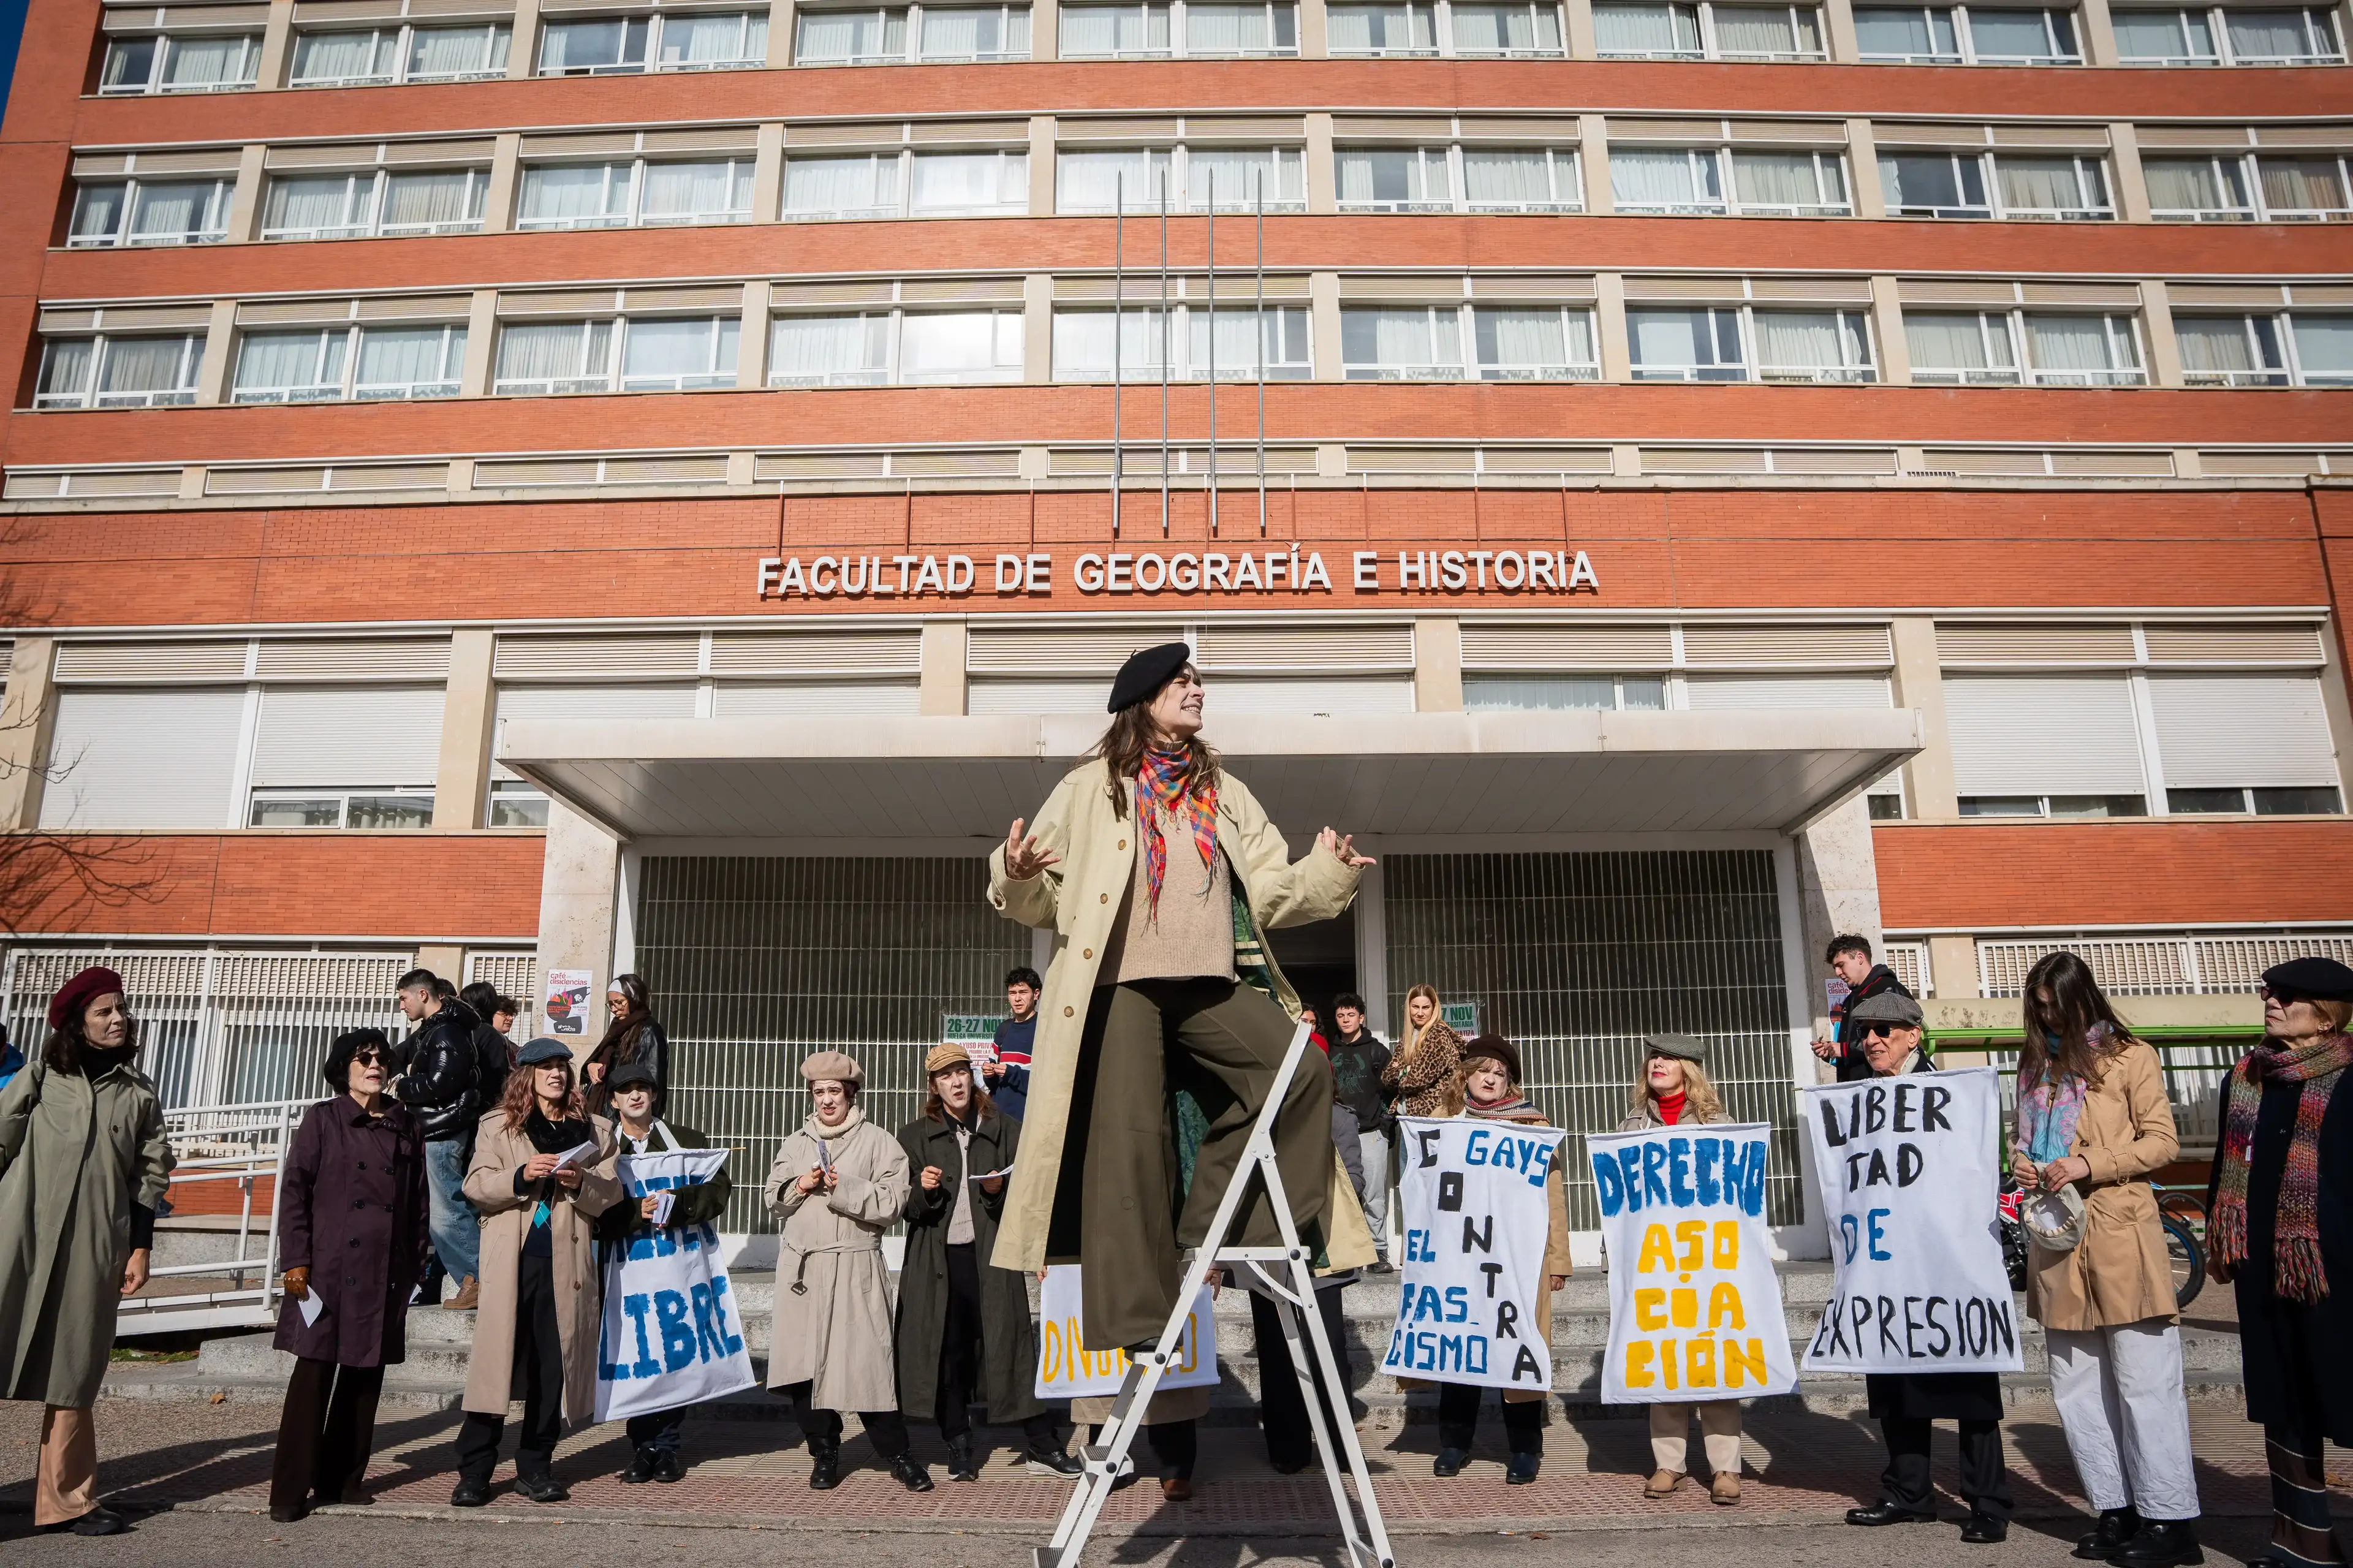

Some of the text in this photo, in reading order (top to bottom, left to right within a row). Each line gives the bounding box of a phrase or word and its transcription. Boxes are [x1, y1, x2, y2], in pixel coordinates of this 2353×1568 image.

[757, 542, 1600, 594] FACULTAD DE GEOGRAFÍA E HISTORIA
[947, 1018, 980, 1032] 26-27
[1450, 1006, 1472, 1021] NOV
[1820, 1083, 1953, 1148] LIBER
[1465, 1130, 1554, 1187] GAYS
[1593, 1138, 1767, 1218] DERECHO
[1846, 1143, 1924, 1193] TAD
[1407, 1229, 1436, 1263] EL
[1637, 1220, 1739, 1273] ASO
[1841, 1208, 1892, 1266] DE
[599, 1275, 743, 1382] LIBRE
[1634, 1273, 1746, 1332] CIA
[1811, 1292, 2014, 1359] EXPRESION
[1625, 1330, 1768, 1390] CIÓN
